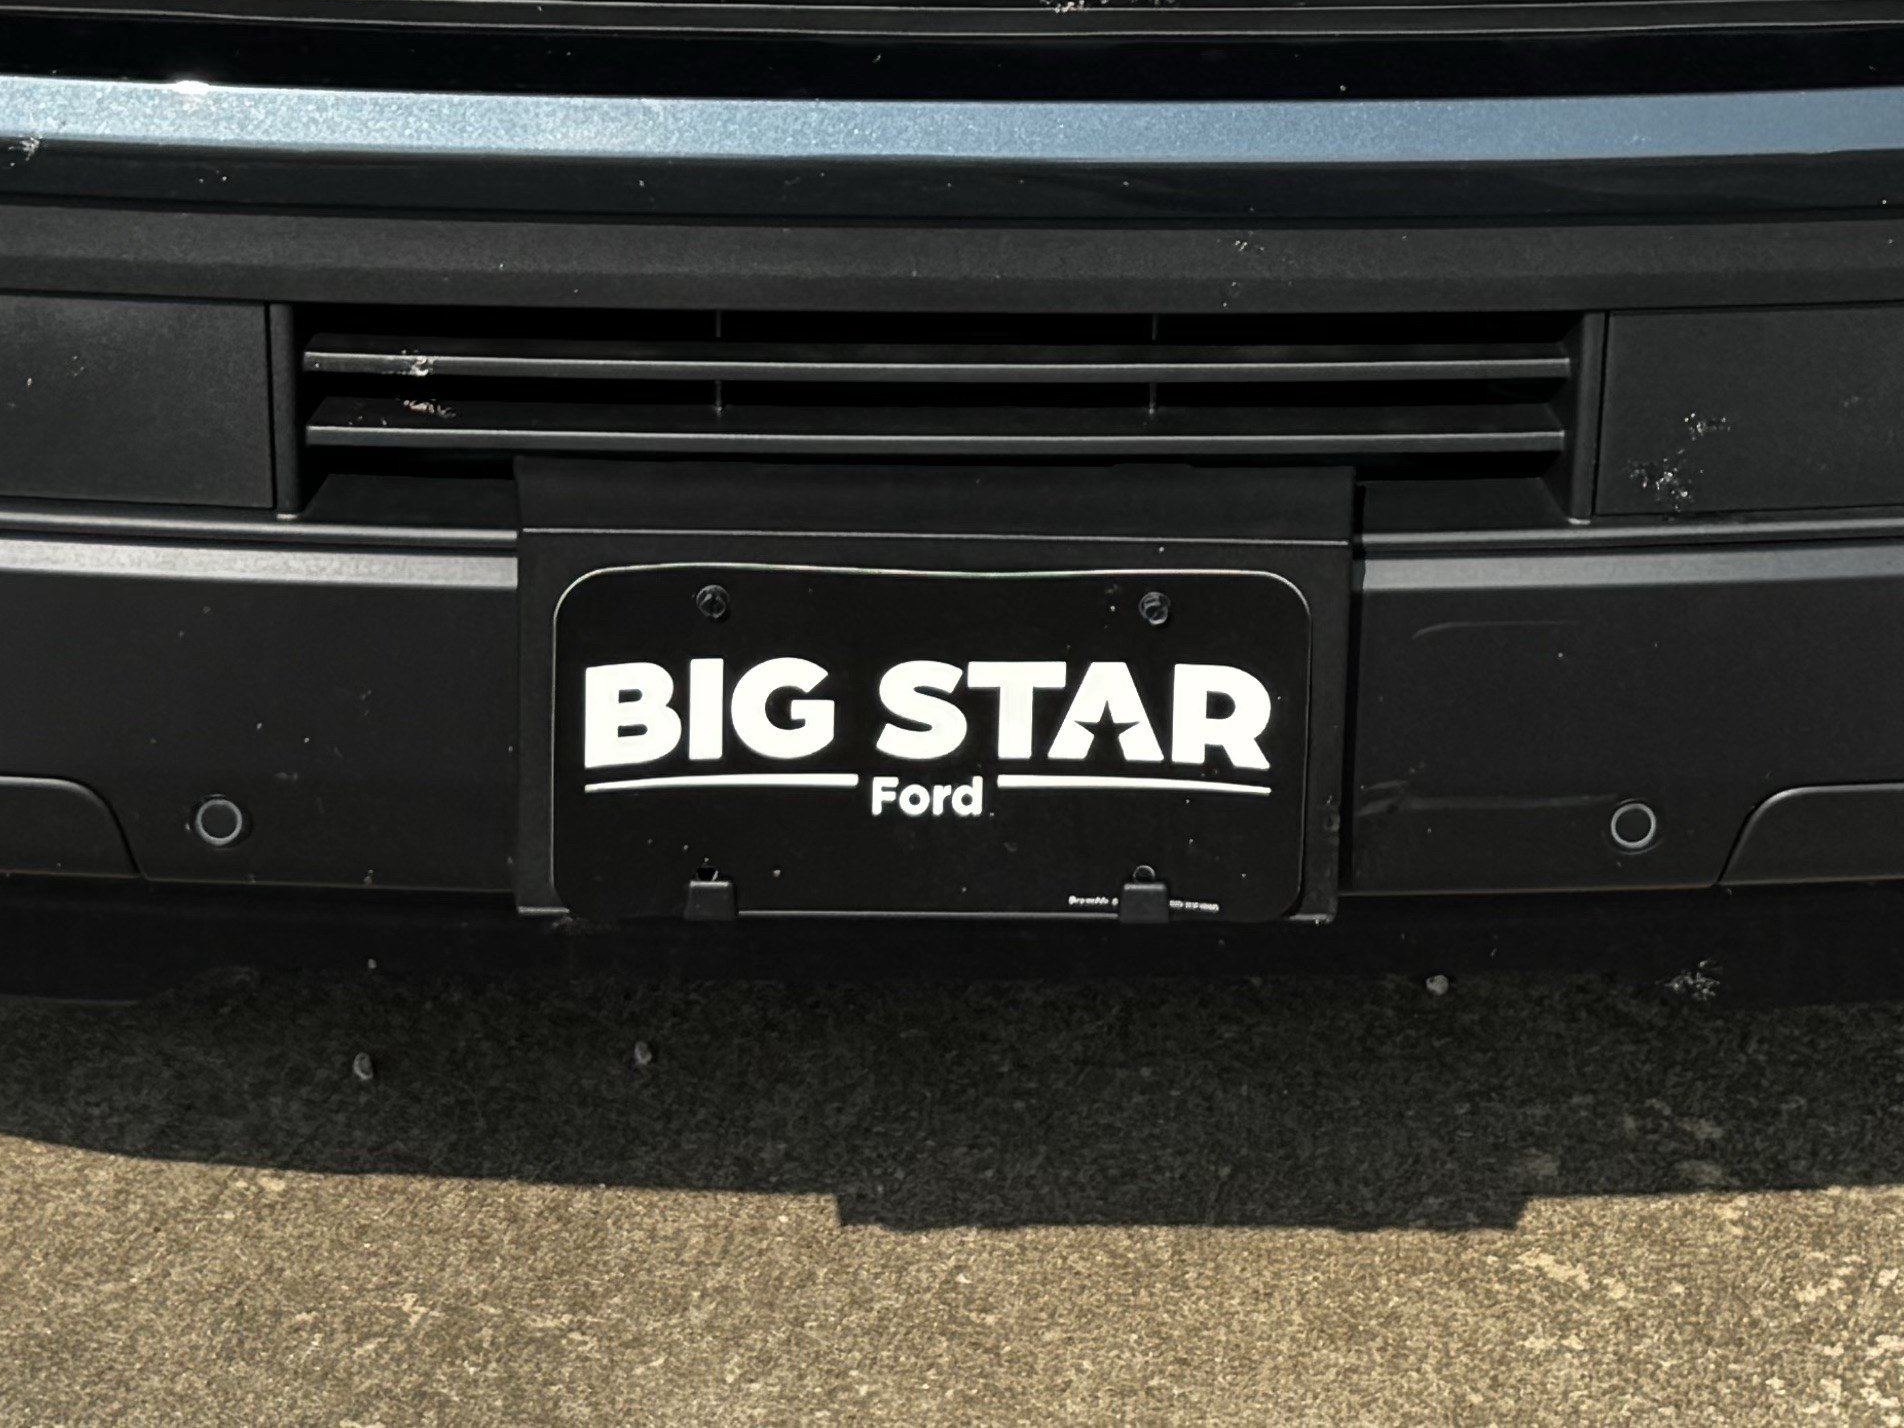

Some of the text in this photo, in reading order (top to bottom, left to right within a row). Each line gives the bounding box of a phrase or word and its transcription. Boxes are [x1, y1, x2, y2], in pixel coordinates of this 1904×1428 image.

[583, 657, 1273, 771] BIG STAR
[871, 776, 984, 817] Ford
